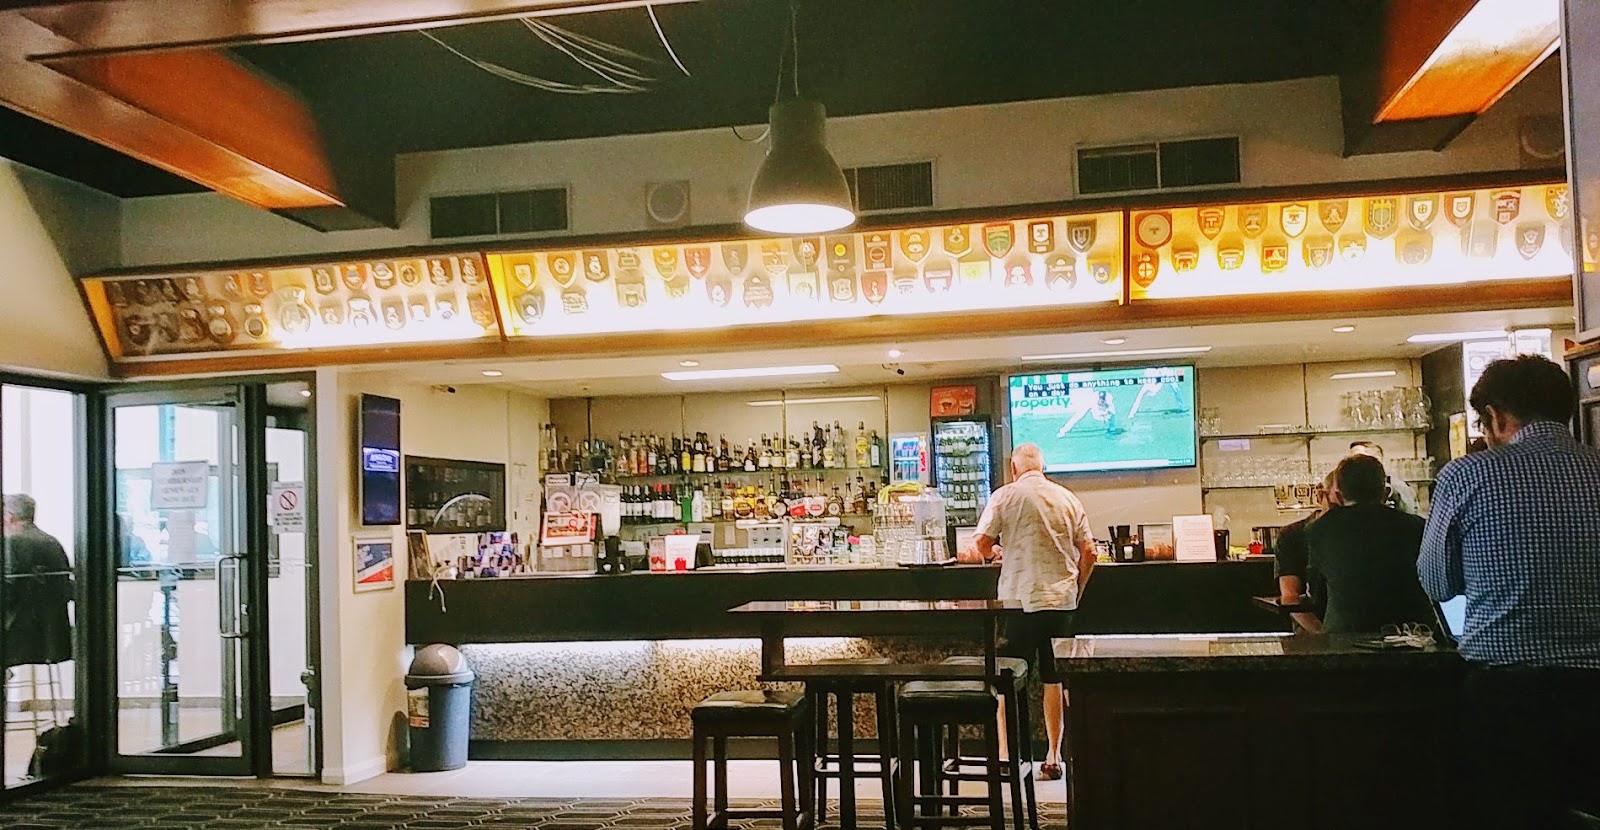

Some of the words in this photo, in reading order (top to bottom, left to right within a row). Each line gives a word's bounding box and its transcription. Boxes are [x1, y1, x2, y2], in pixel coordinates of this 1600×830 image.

[1027, 383, 1043, 391] You
[1069, 381, 1080, 389] do
[1082, 378, 1121, 388] anything
[1124, 377, 1135, 385] to
[1028, 390, 1039, 398] on
[1051, 388, 1066, 397] day
